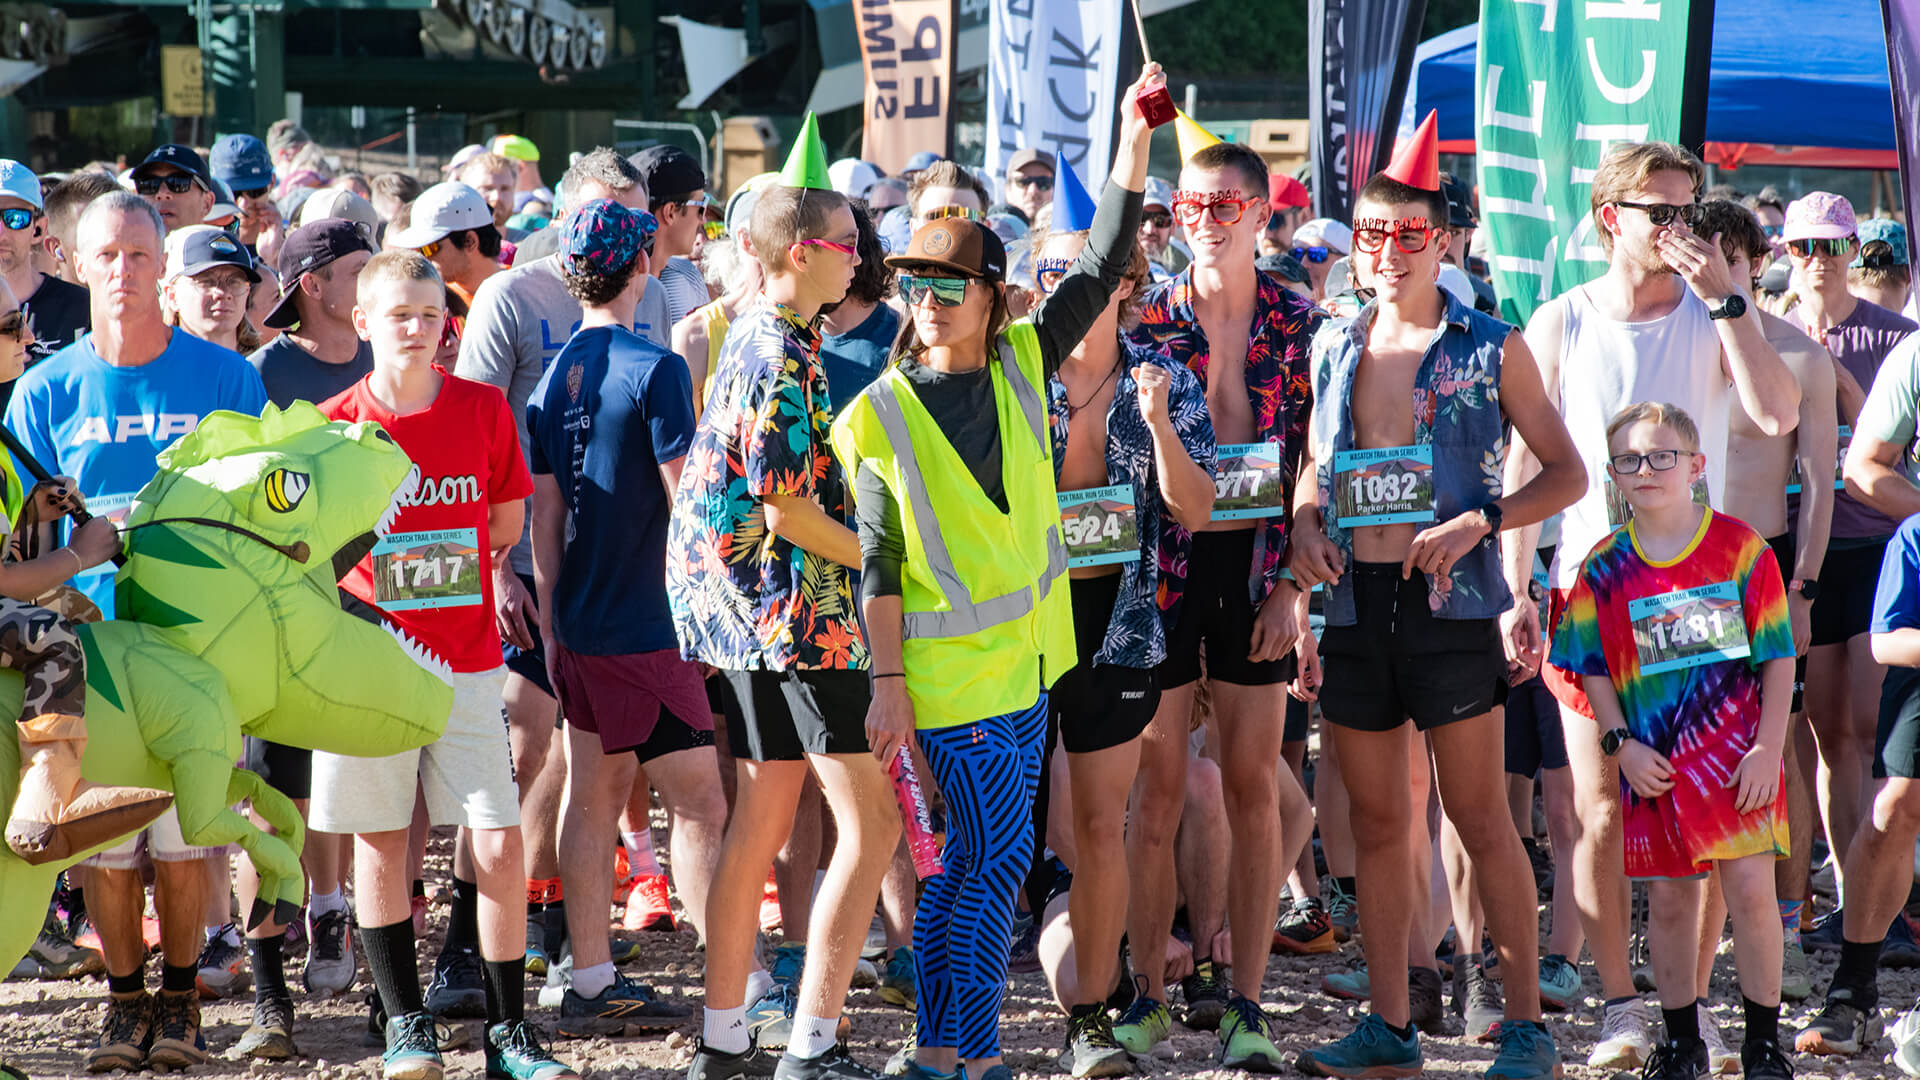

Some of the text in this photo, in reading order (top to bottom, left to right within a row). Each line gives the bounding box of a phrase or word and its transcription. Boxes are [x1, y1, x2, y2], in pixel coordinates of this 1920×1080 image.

[1400, 447, 1418, 456] SERIES
[1098, 488, 1117, 498] SERIES
[1351, 471, 1418, 504] 1032
[1357, 502, 1413, 513] Parker Harris
[1064, 512, 1121, 546] 524
[414, 533, 429, 542] TRAIL
[390, 556, 463, 588] 1717
[1701, 585, 1721, 596] SERIES
[1651, 609, 1724, 649] 1481
